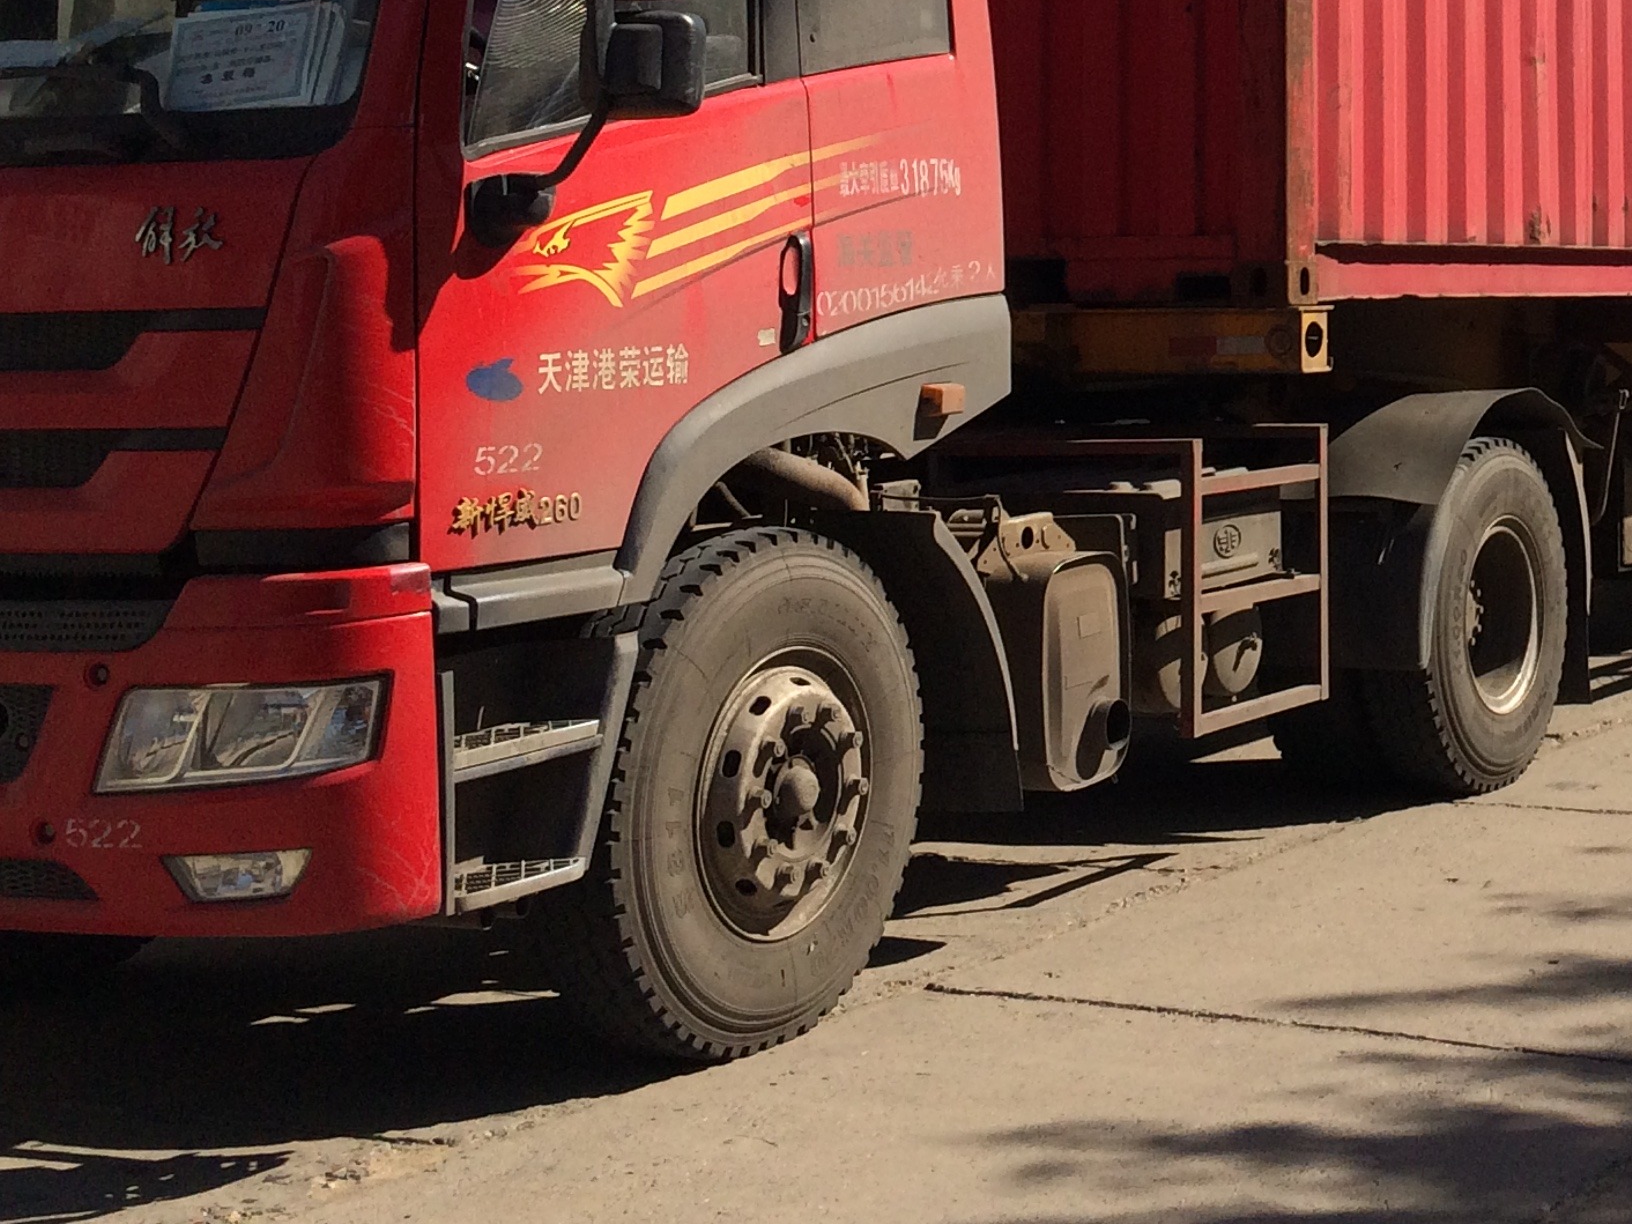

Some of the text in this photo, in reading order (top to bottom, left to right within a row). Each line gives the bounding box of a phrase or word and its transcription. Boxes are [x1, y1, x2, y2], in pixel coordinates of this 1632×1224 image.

[537, 343, 689, 395] 天津港荣运输
[474, 442, 543, 476] 522
[65, 818, 143, 848] 522
